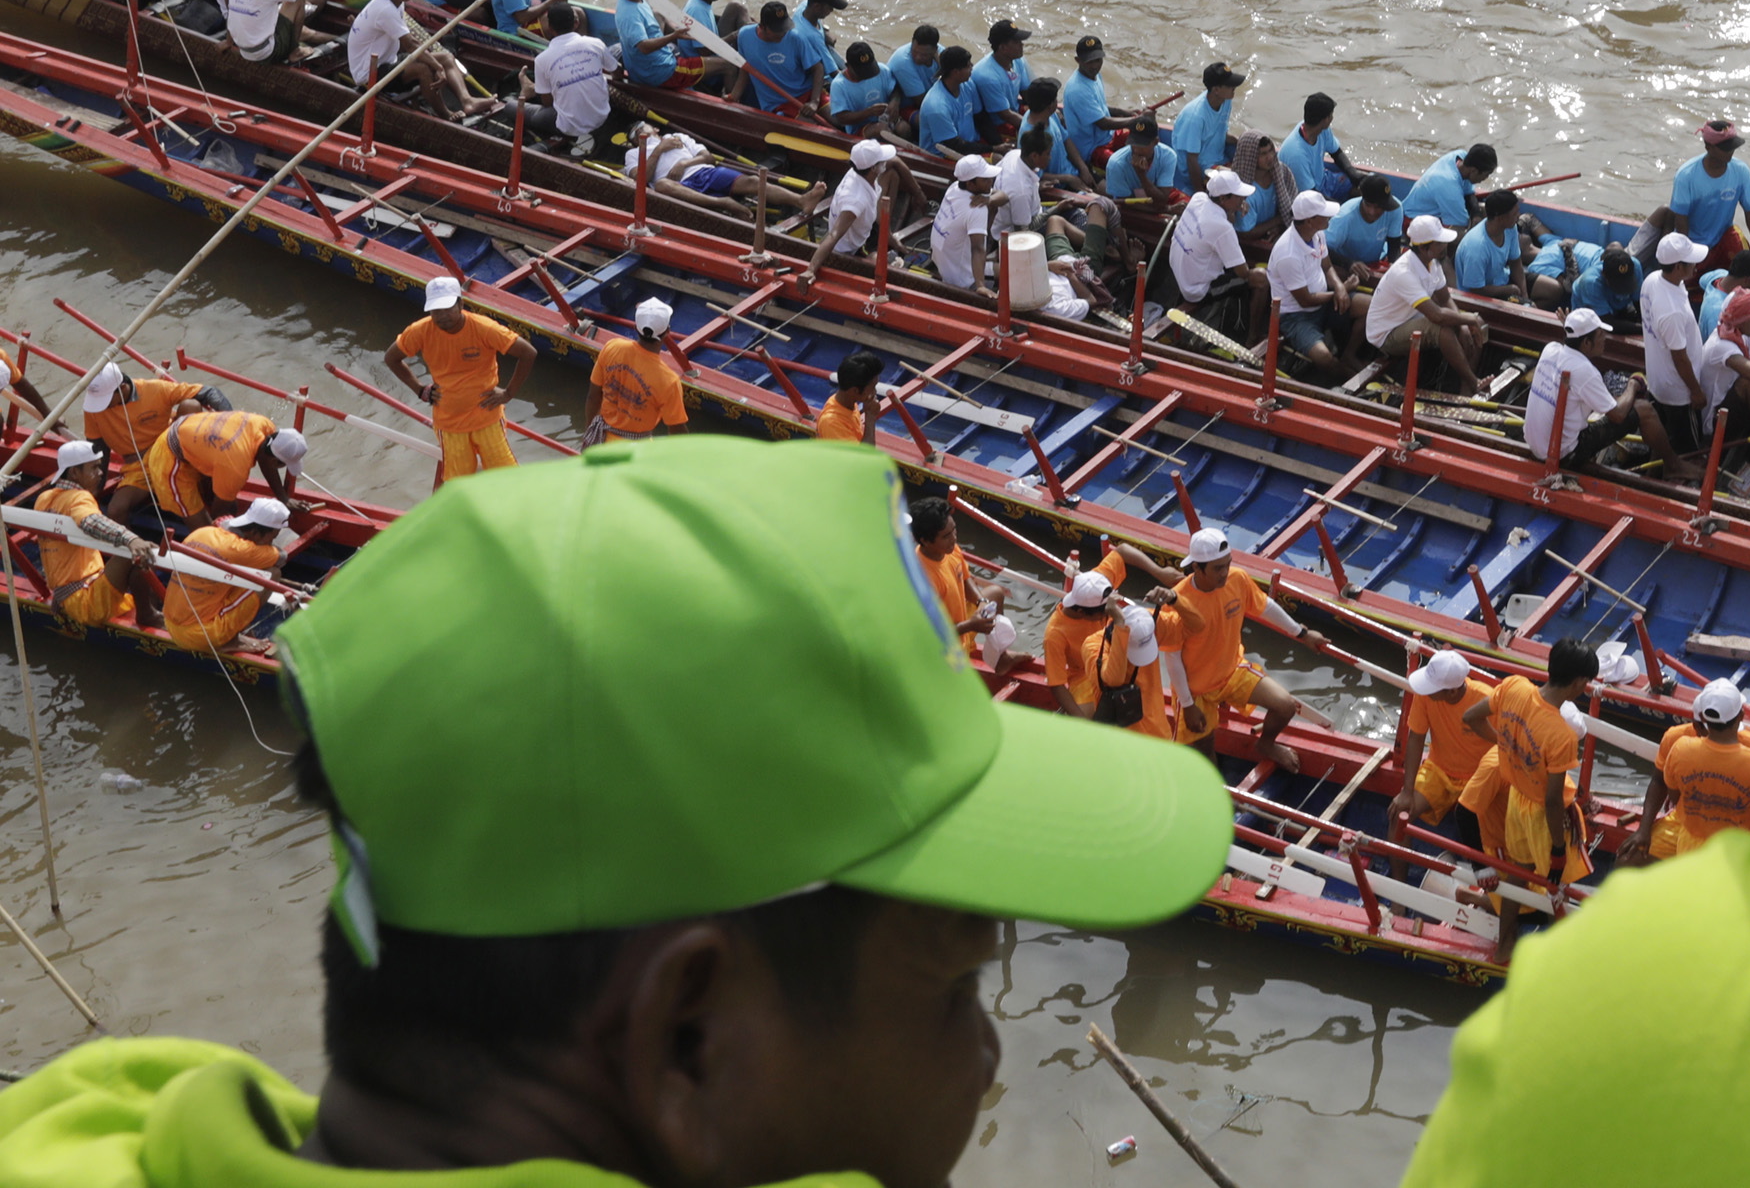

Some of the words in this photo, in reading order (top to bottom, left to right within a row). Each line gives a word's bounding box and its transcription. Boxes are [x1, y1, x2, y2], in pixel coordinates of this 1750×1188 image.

[680, 15, 694, 29] 32
[351, 157, 366, 172] 42
[497, 201, 512, 213] 40
[743, 268, 758, 283] 36
[863, 302, 879, 319] 34
[988, 337, 1003, 350] 32
[1118, 373, 1134, 385] 30
[1533, 487, 1549, 504] 24
[1682, 530, 1703, 548] 22
[1268, 864, 1283, 881] 19
[1455, 907, 1470, 926] 17
